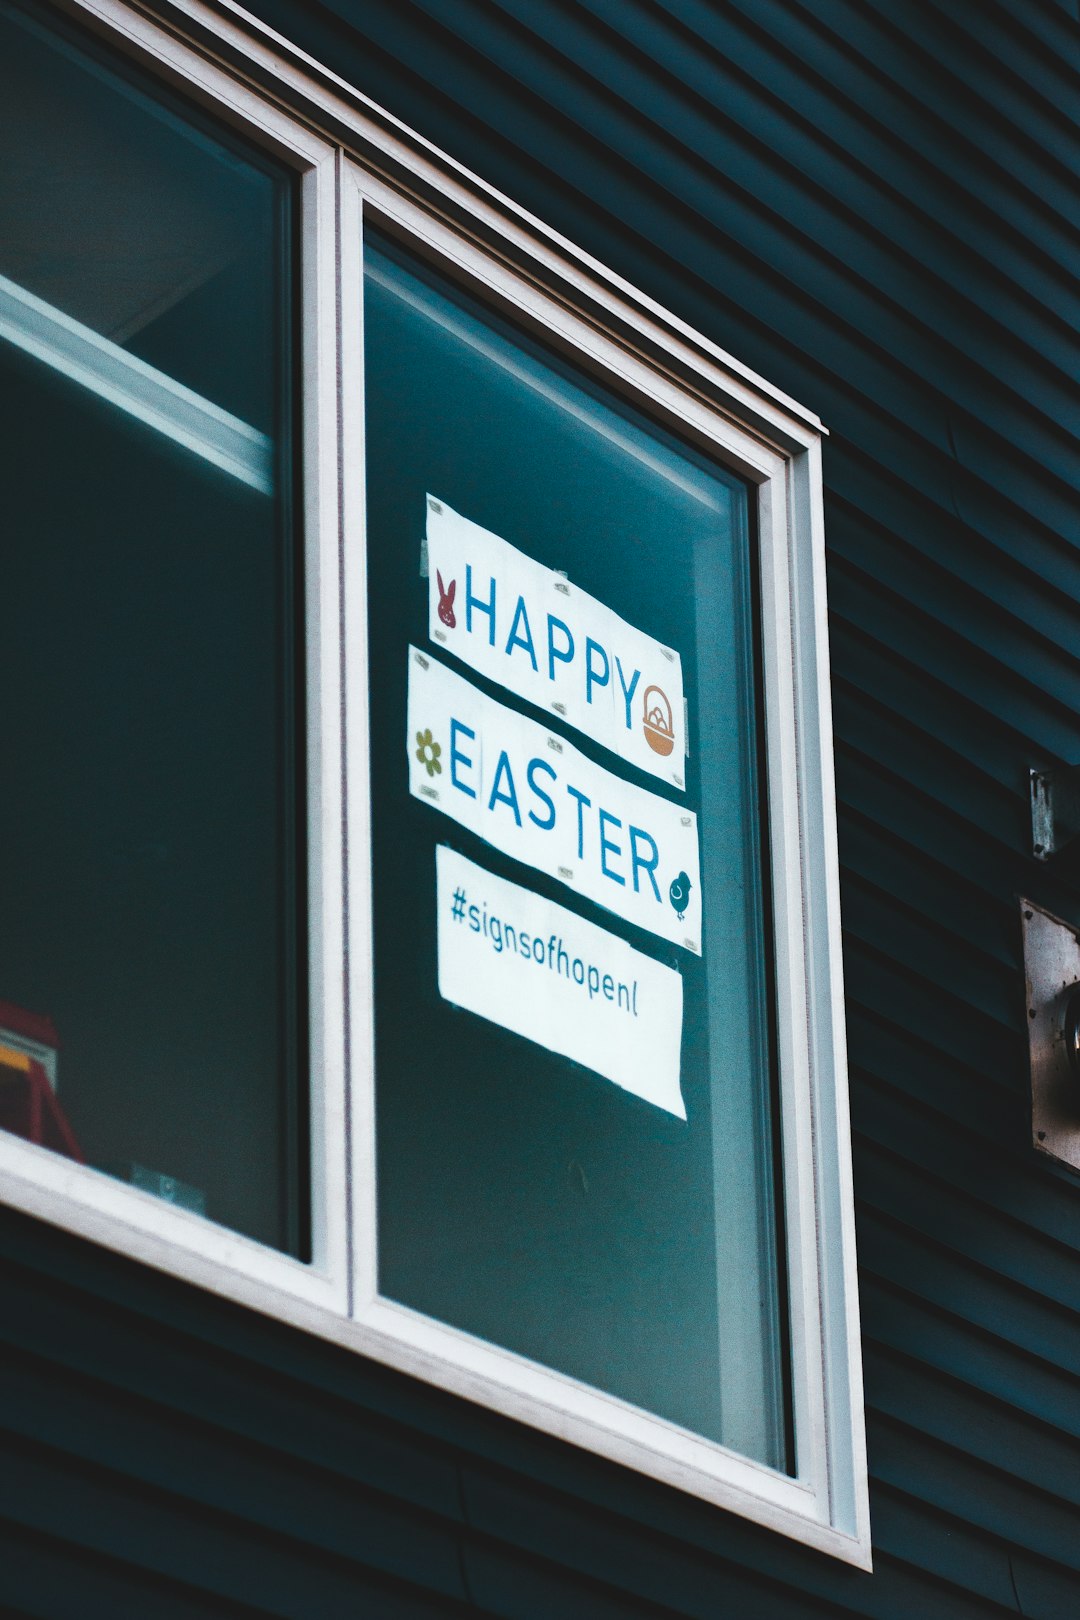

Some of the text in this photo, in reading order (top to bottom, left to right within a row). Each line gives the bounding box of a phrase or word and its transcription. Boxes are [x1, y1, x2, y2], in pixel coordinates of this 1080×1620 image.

[465, 564, 641, 730] HAPPY
[450, 718, 662, 903] EASTER
[451, 887, 639, 1016] #signsofhopenl
